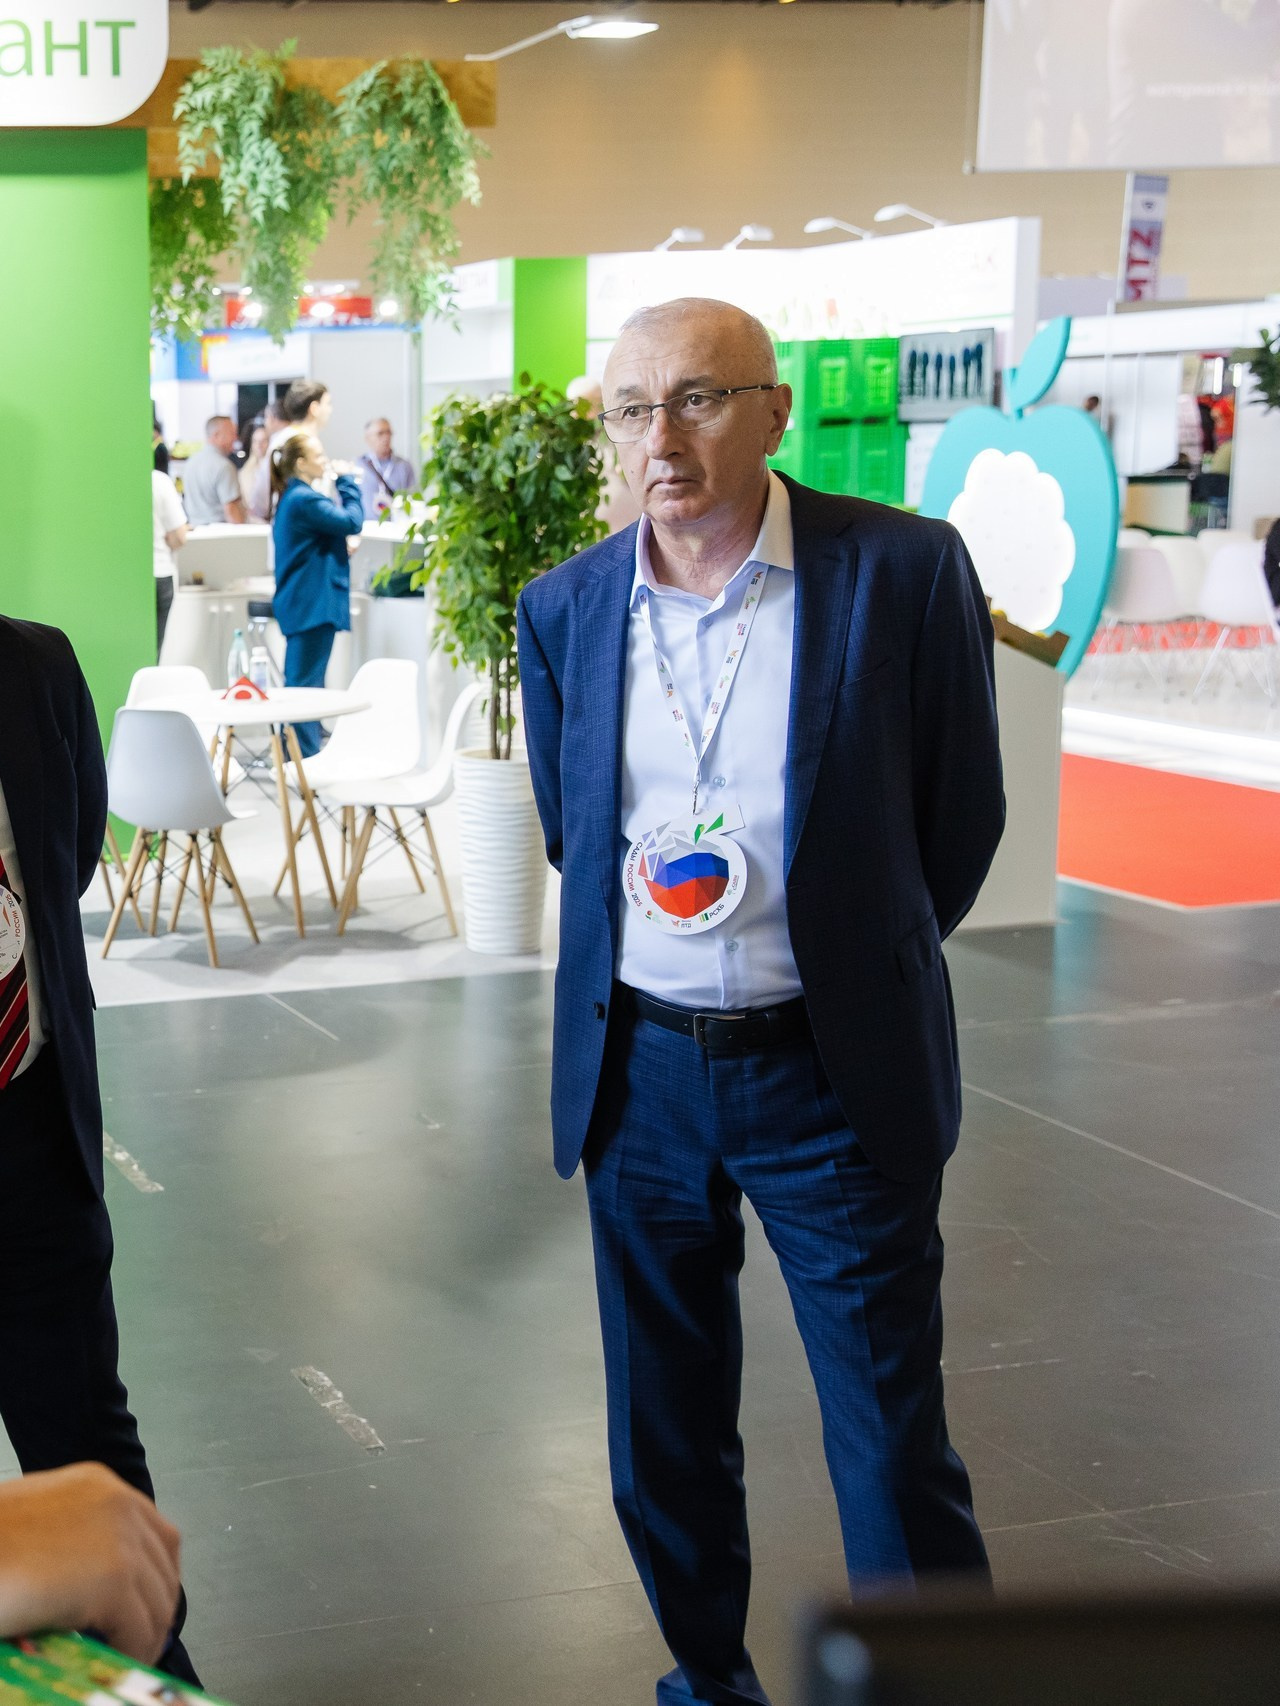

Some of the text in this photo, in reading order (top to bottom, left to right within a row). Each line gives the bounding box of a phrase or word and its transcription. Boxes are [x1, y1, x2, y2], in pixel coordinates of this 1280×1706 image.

[627, 841, 643, 907] САДЫ РОССИИ 2025
[12, 909, 21, 938] РОССИИ
[709, 903, 725, 919] РСХБ
